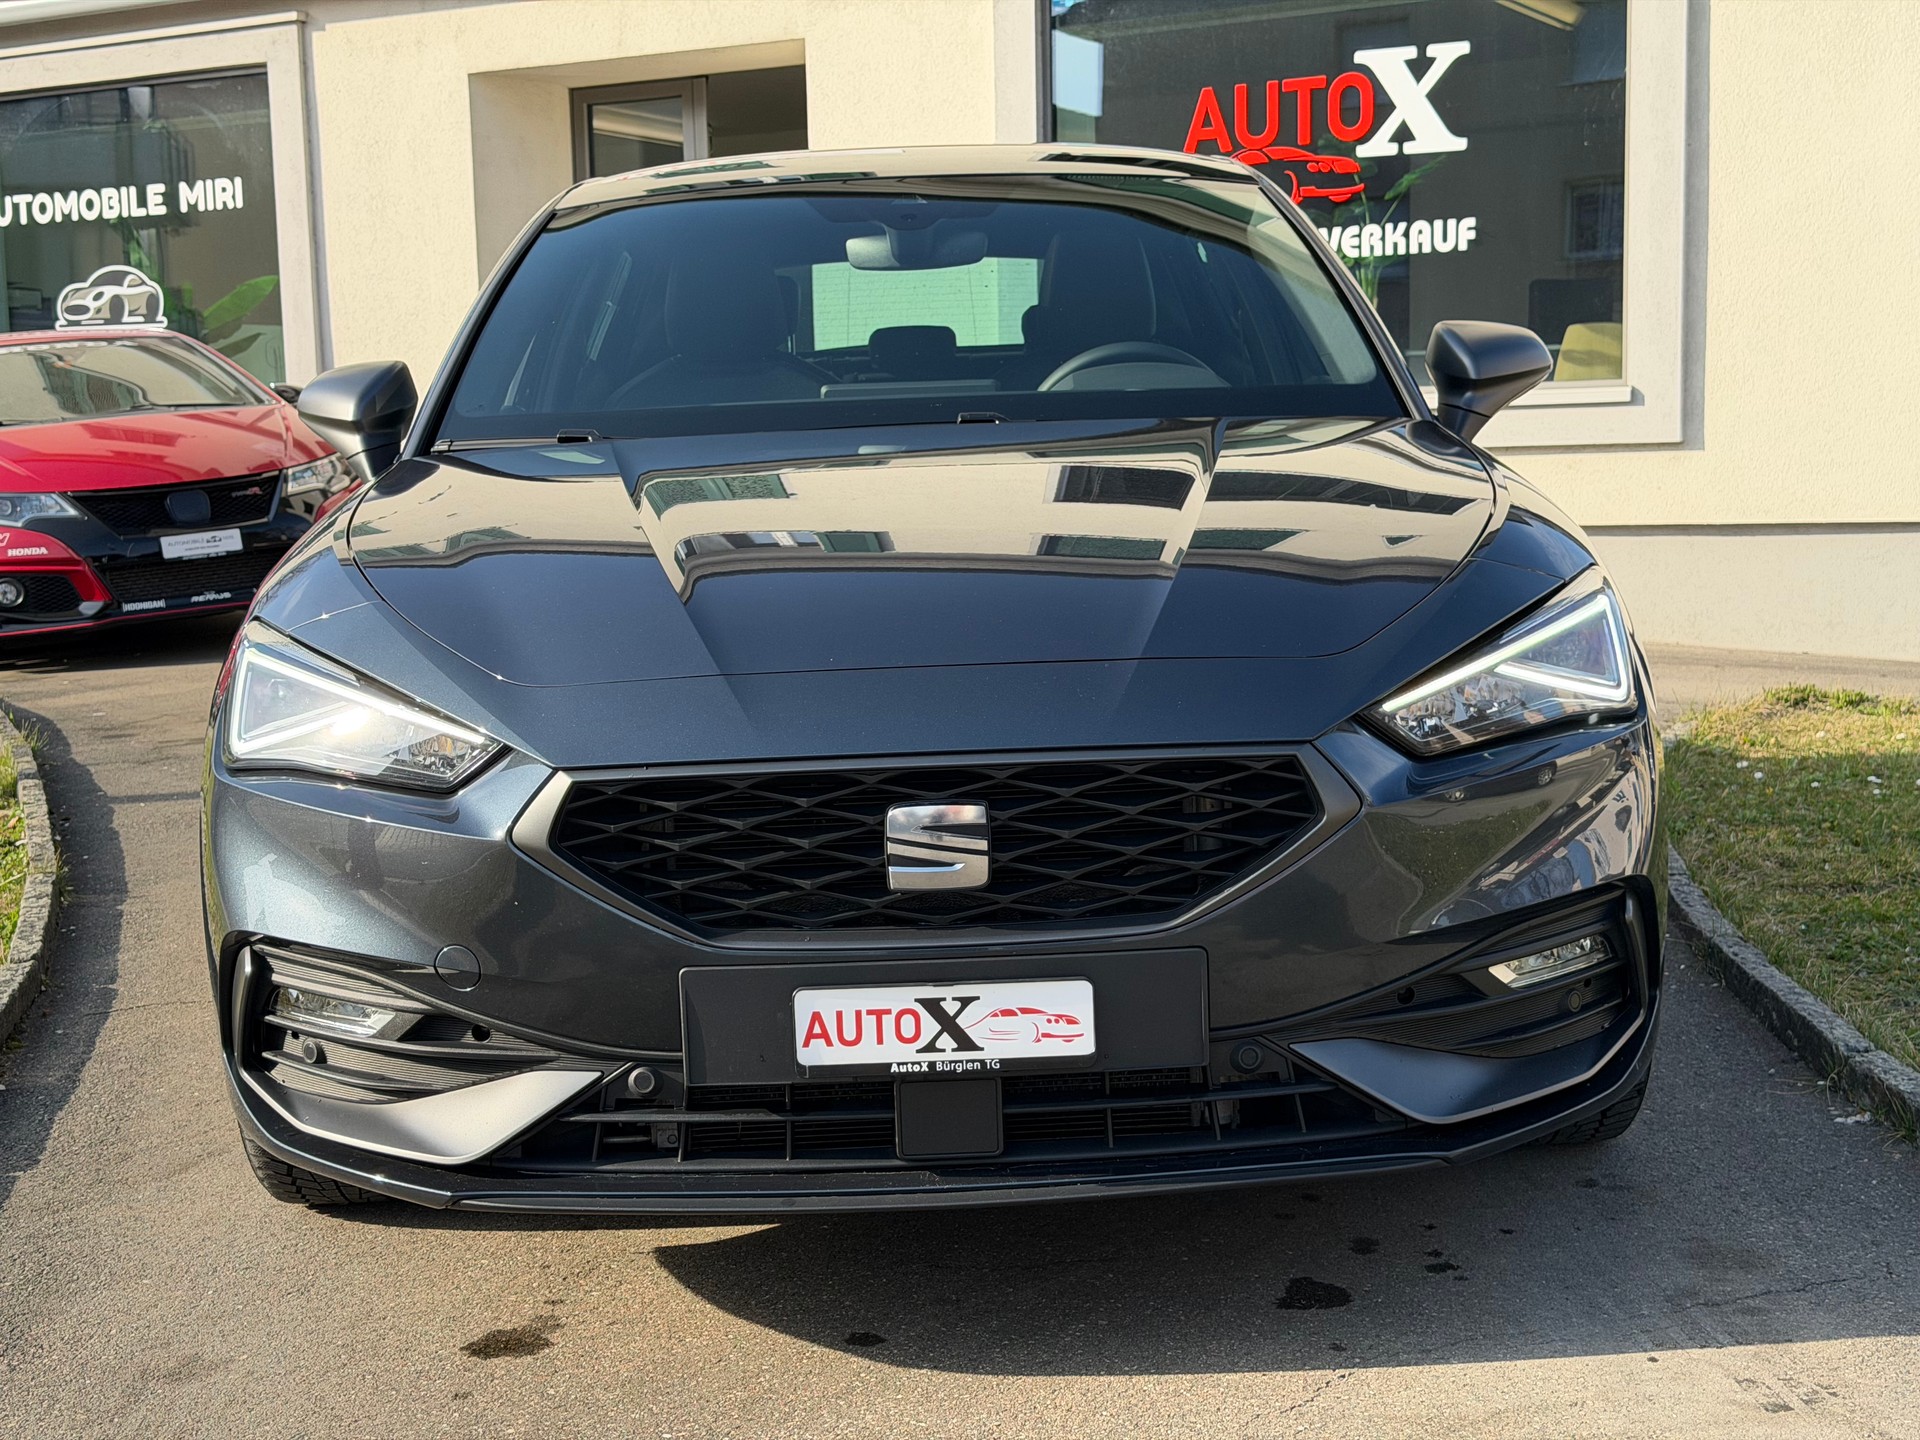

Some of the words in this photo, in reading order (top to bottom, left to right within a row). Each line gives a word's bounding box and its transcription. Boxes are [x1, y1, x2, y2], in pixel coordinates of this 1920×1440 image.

[178, 176, 244, 213] MIRI
[7, 546, 49, 557] HONDA
[190, 591, 232, 603] REMUS
[891, 1061, 929, 1073] AutoX
[936, 1060, 981, 1073] Bürglen
[985, 1059, 1000, 1070] TG
